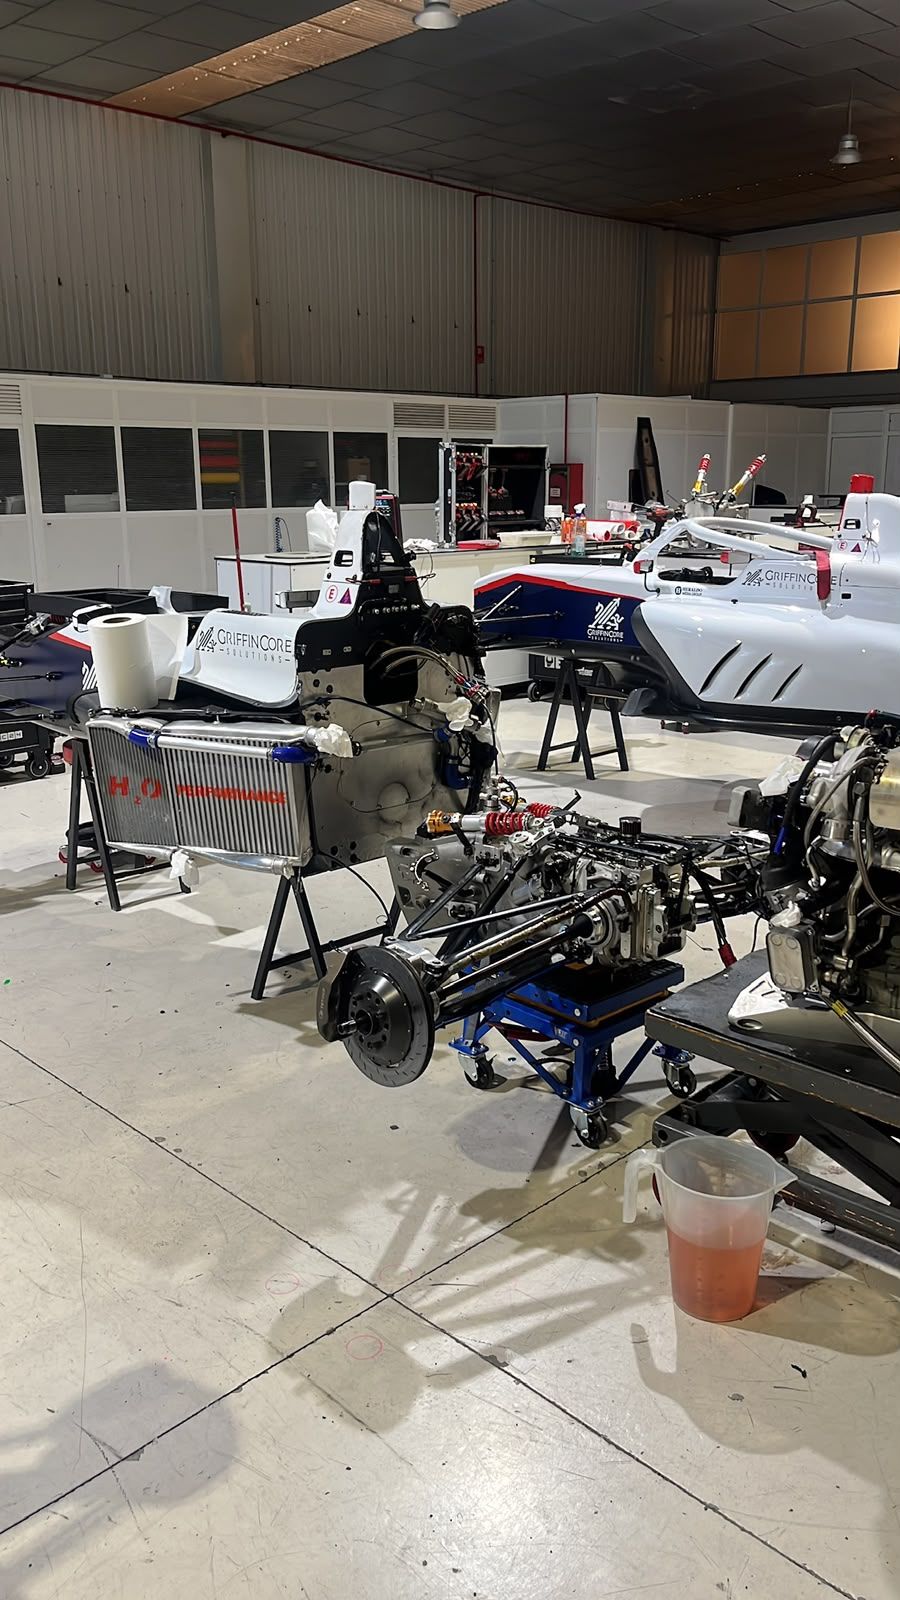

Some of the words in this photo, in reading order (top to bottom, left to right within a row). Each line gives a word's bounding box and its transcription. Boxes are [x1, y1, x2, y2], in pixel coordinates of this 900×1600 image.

[765, 570, 837, 585] GRIFFINCE
[329, 588, 335, 600] E
[227, 648, 282, 663] SOLUTIONS
[176, 784, 287, 805] PERFORMANCE
